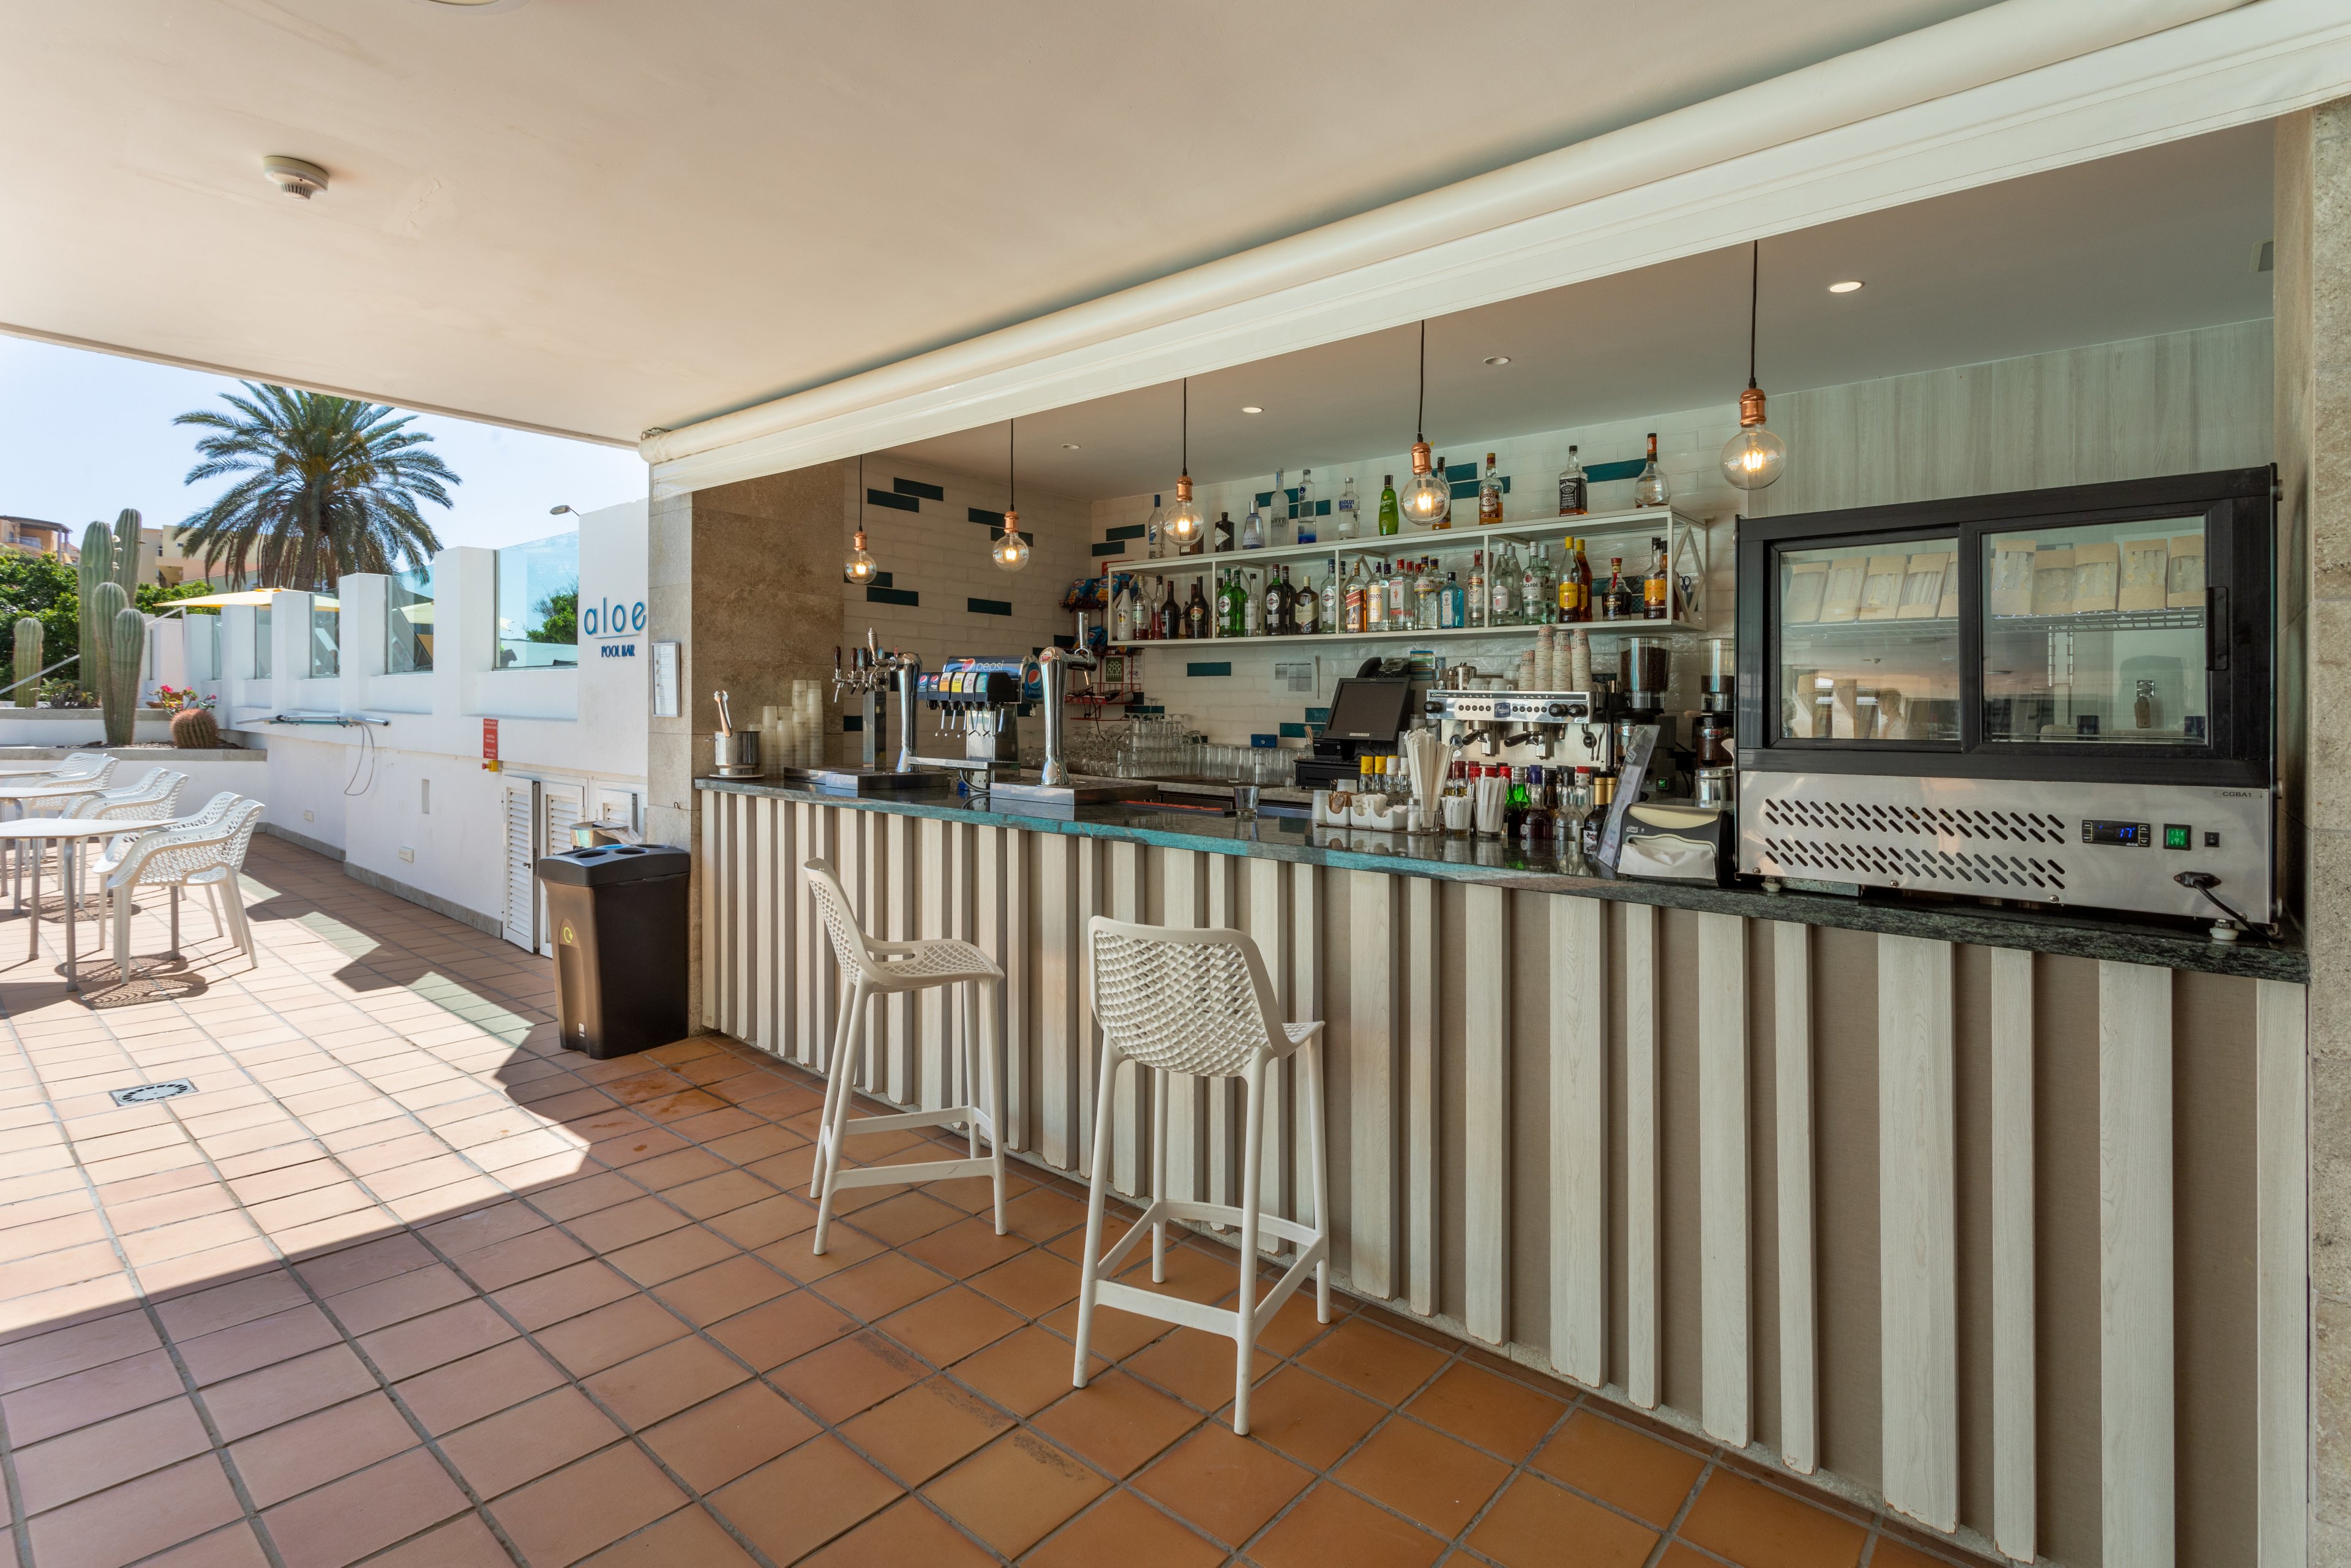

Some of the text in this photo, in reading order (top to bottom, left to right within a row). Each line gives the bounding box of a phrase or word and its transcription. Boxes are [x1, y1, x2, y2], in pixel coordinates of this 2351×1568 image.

[584, 597, 647, 635] aloe
[601, 644, 635, 658] POOL BAR
[976, 660, 1004, 672] pepsi
